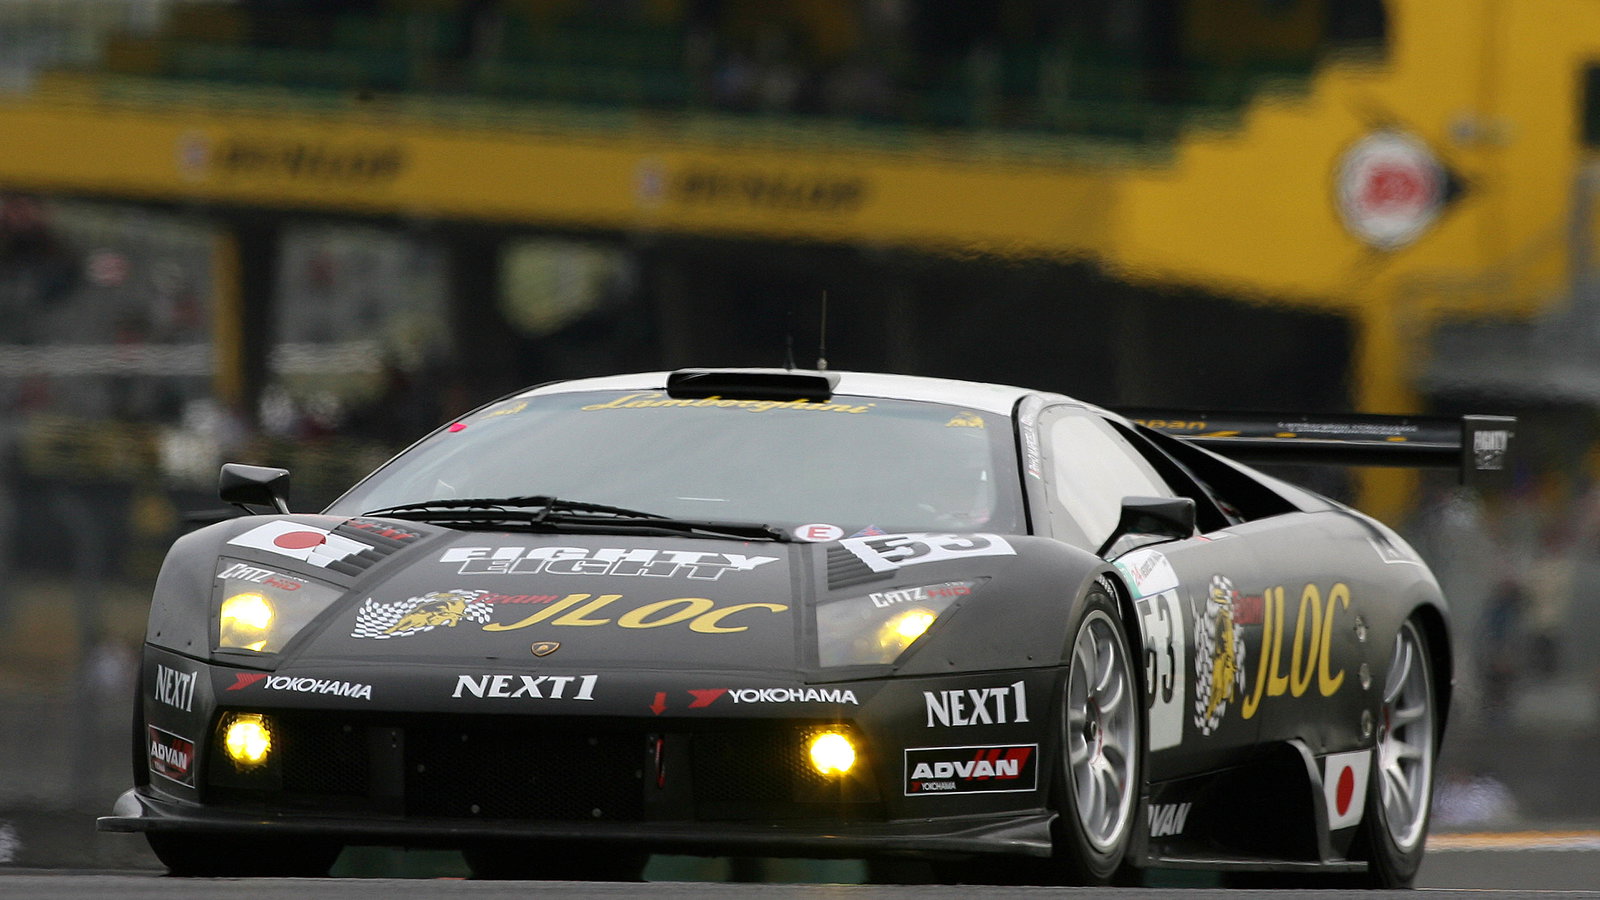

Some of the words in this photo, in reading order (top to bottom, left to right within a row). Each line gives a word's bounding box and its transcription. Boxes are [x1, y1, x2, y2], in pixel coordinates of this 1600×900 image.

[806, 526, 832, 539] E
[439, 546, 781, 571] EIGHTY
[457, 557, 740, 582] EIGHT
[217, 563, 276, 583] CATZ
[869, 586, 929, 609] CATZ
[482, 593, 789, 634] JLOC
[1242, 582, 1350, 720] JLOC
[155, 664, 198, 713] NEXT1
[264, 675, 372, 701] YOKOHAMA
[451, 674, 599, 701] NEXT1
[727, 688, 860, 706] YOKOHAMA
[922, 680, 1030, 728] NEXT1
[150, 741, 188, 771] ADVAN
[911, 759, 1019, 780] ADVAN
[921, 781, 957, 791] YOKOHAMA
[1147, 802, 1193, 837] VAN
